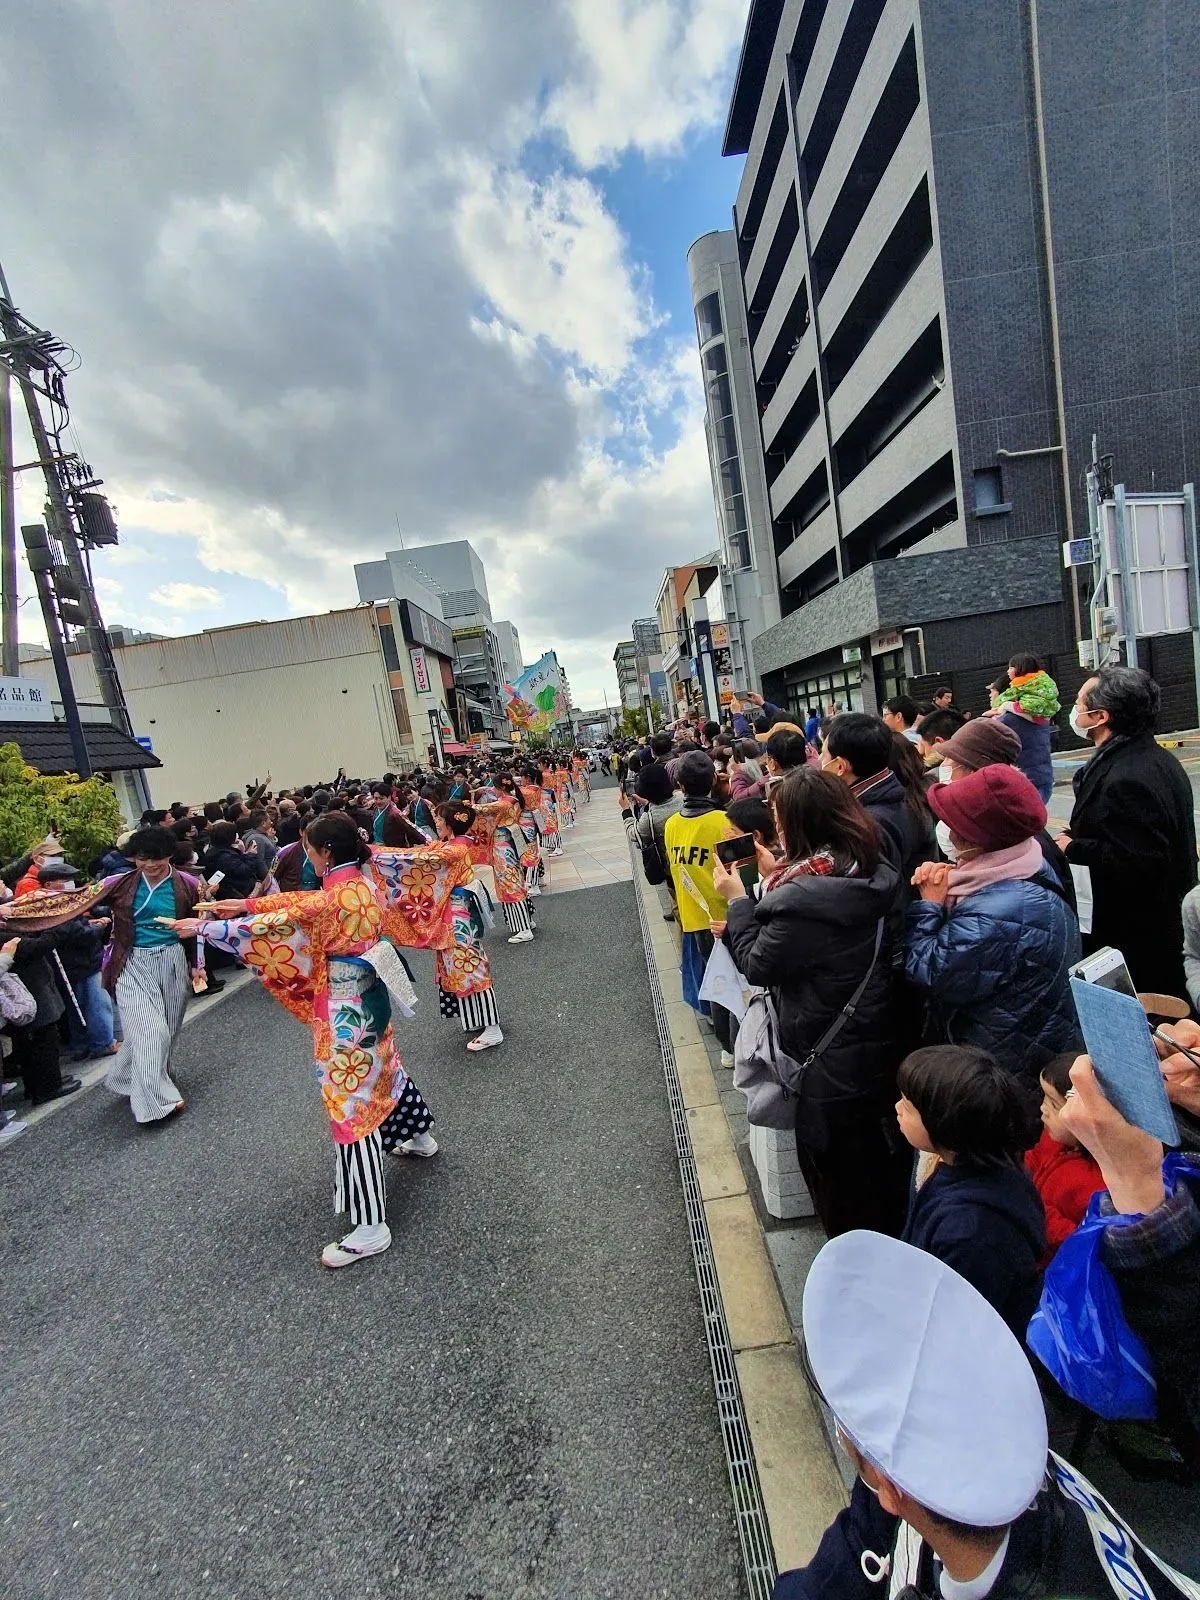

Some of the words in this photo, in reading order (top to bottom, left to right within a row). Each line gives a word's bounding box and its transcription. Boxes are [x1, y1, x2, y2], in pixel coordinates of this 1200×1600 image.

[415, 656, 426, 690] サイゼリヤ
[671, 846, 710, 867] TAFF
